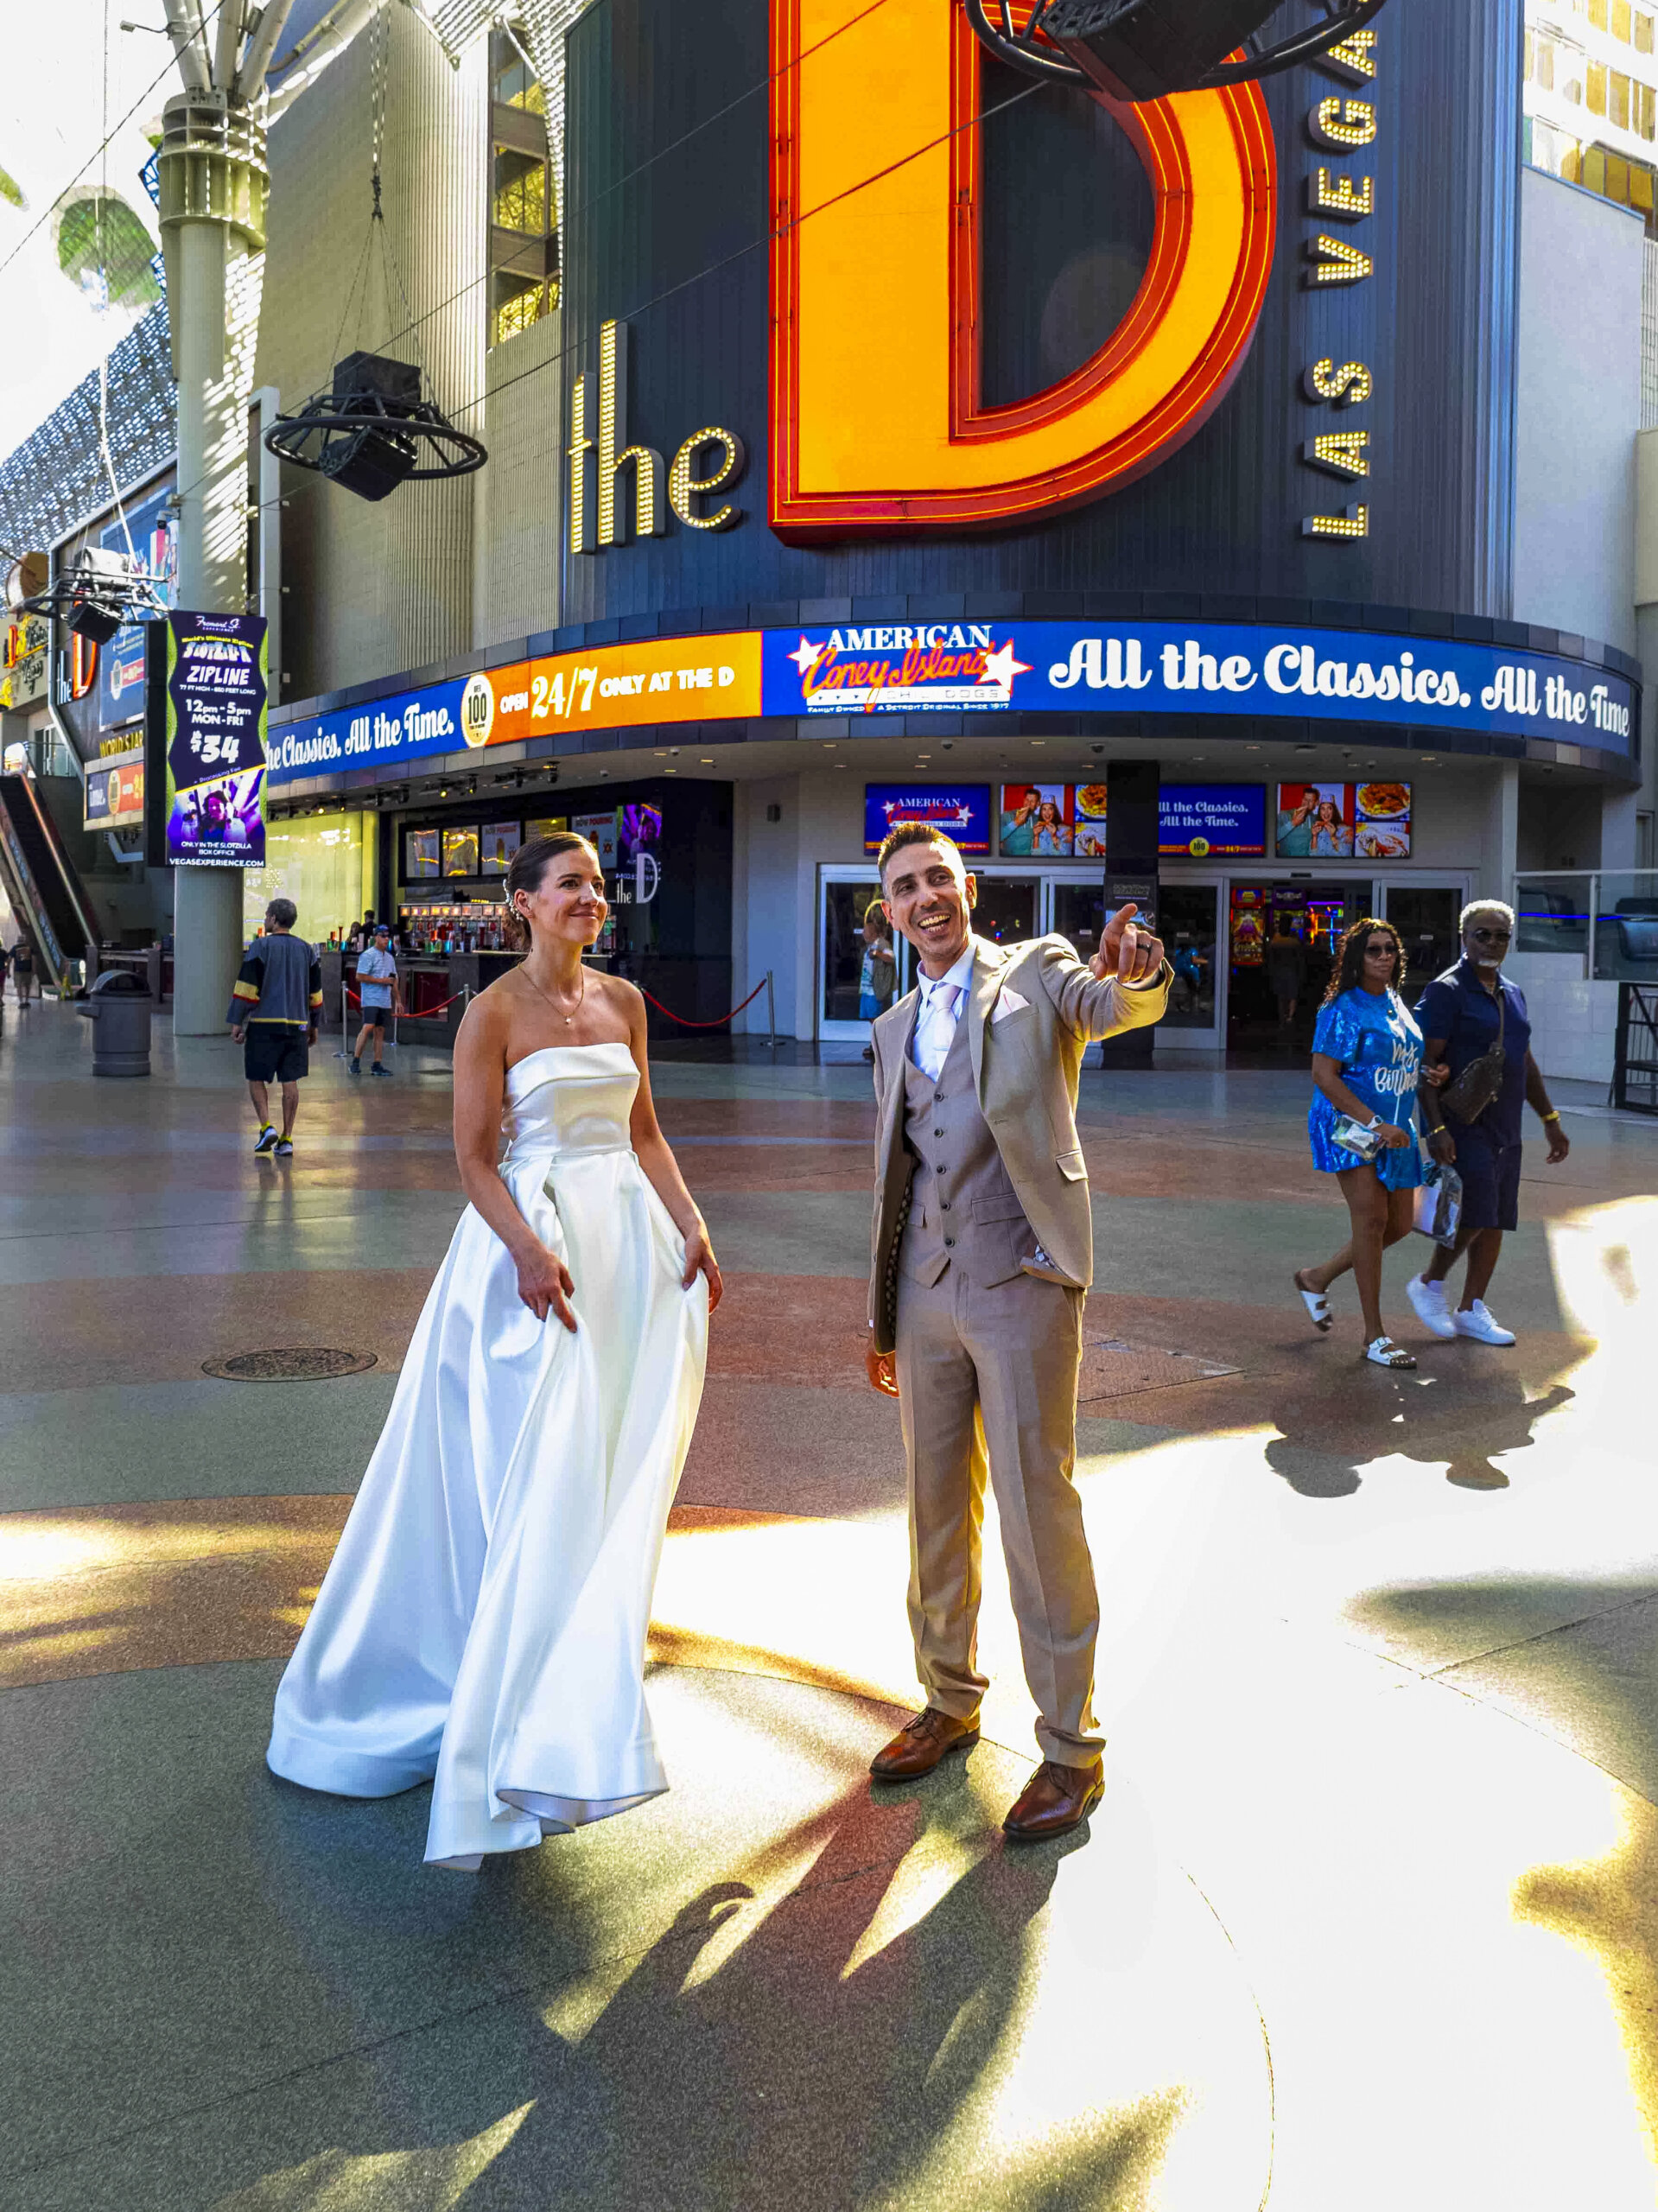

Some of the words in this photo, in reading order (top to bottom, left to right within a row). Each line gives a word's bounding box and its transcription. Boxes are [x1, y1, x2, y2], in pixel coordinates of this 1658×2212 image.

[1308, 0, 1378, 289] VEGA
[566, 320, 746, 555] the
[769, 0, 1277, 546] D
[1305, 357, 1375, 539] LAS
[827, 625, 993, 652] AMERICAN
[186, 665, 251, 685] ZIPLINE
[802, 647, 890, 699] Coney
[887, 638, 995, 688] Island
[500, 691, 529, 714] OPEN
[531, 666, 598, 719] 24/7
[599, 674, 645, 697] ONLY
[649, 671, 673, 692] AT
[677, 668, 713, 690] THE
[718, 666, 735, 687] D
[1048, 639, 1153, 689] All
[1159, 640, 1258, 692] the
[1263, 644, 1471, 709] Classics.
[1481, 665, 1541, 716] All
[1545, 675, 1588, 724] the
[1590, 685, 1630, 737] Time
[186, 699, 218, 714] 12pm
[226, 702, 251, 715] 5pm
[467, 692, 486, 724] 100
[190, 730, 240, 764] $34
[283, 727, 341, 767] Classics.
[345, 715, 372, 755] All
[373, 712, 403, 749] the
[403, 702, 454, 742] Time.
[897, 798, 960, 808] AMERICAN
[1173, 802, 1193, 812] the
[1195, 802, 1248, 813] Classics.
[1159, 816, 1180, 826] All
[1183, 816, 1203, 826] the
[1204, 816, 1239, 826] Time.
[169, 858, 264, 867] VEGASEXPERIENCE.COM
[617, 879, 632, 904] the
[637, 853, 657, 904] D
